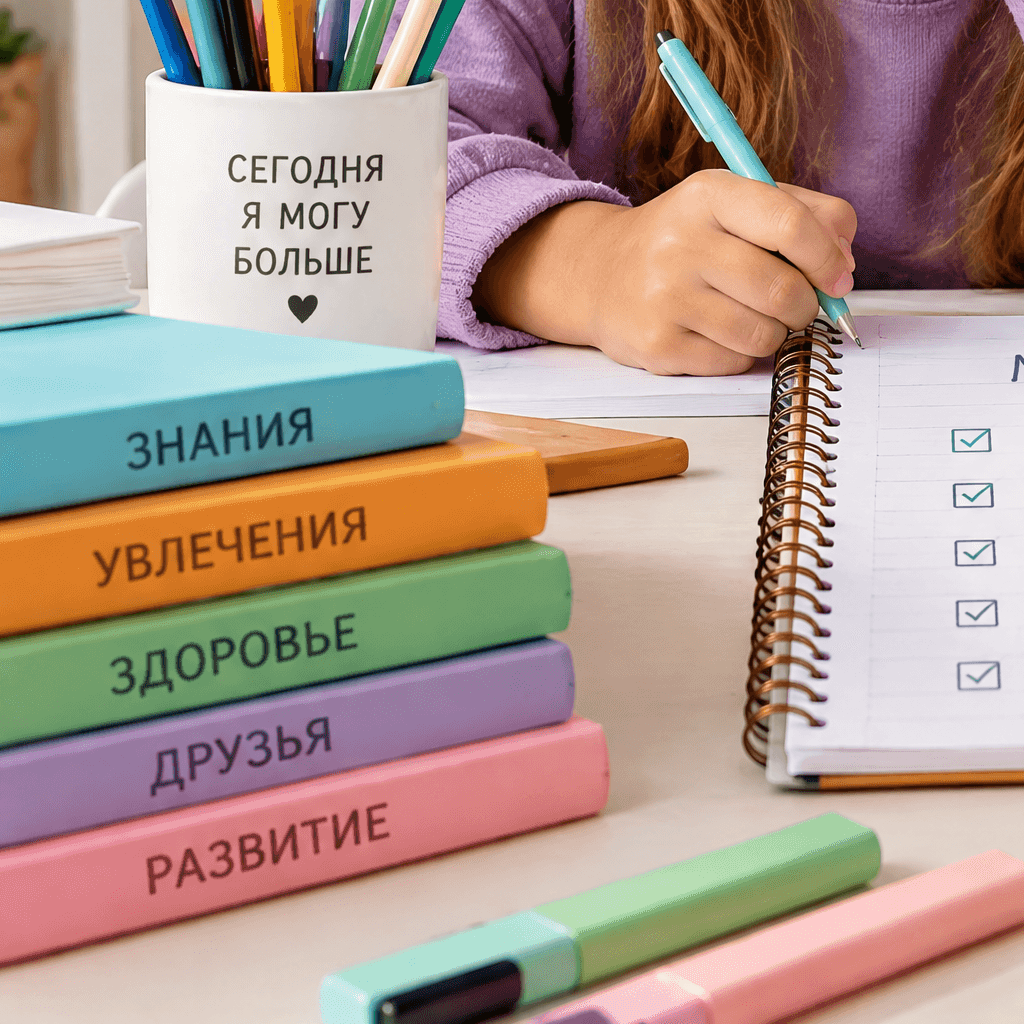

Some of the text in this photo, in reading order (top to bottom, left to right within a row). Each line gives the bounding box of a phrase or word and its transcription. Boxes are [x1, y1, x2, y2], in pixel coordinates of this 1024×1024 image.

[227, 153, 384, 189] СЕГОДНЯ
[241, 200, 370, 230] Я МОГУ
[234, 245, 373, 276] БОЛЬШЕ
[126, 406, 314, 471] ЗНАНИЯ
[92, 505, 367, 589] УВЛЕЧЕНИЯ
[110, 612, 358, 698] ЗДОРОВЬЕ
[150, 716, 332, 797] ДРУЗЬЯ
[146, 802, 390, 896] РАЗВИТИЕ
